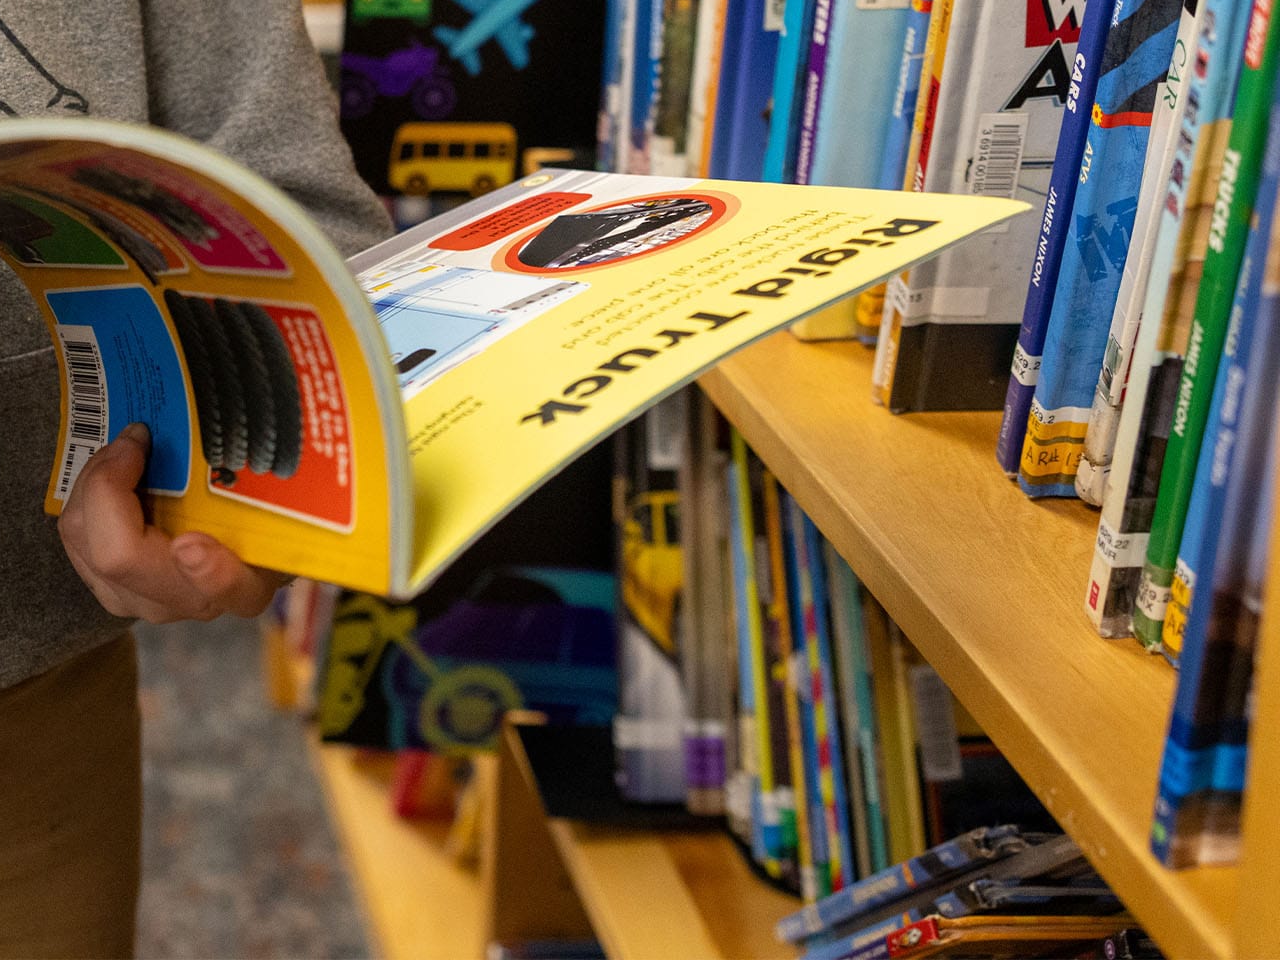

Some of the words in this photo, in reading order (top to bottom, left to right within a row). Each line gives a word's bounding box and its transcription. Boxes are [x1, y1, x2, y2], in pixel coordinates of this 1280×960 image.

[1112, 0, 1123, 27] Tieck
[1066, 52, 1086, 114] CARS
[1164, 38, 1187, 111] CAR
[795, 130, 811, 185] LANGLE
[978, 138, 990, 162] 6914
[1080, 141, 1094, 184] ATVs
[1041, 187, 1058, 235] JAMES
[1210, 149, 1241, 253] TRUCKS
[774, 211, 846, 240] behind
[782, 209, 818, 223] the
[806, 214, 873, 240] These
[730, 225, 786, 246] back
[697, 247, 730, 263] are
[731, 218, 942, 299] Rigid
[737, 242, 775, 257] the
[741, 243, 805, 270] trucks
[1032, 235, 1048, 287] NIXON
[669, 264, 694, 277] all
[706, 272, 738, 287] are
[628, 278, 667, 296] one
[648, 283, 696, 301] The
[596, 289, 702, 346] connected
[605, 304, 644, 324] cab
[561, 326, 601, 349] and
[1185, 319, 1203, 376] JAMES
[521, 309, 751, 427] Truck
[1174, 376, 1194, 437] NIXON
[1097, 538, 1117, 560] MUR
[1100, 525, 1130, 550] 629.22
